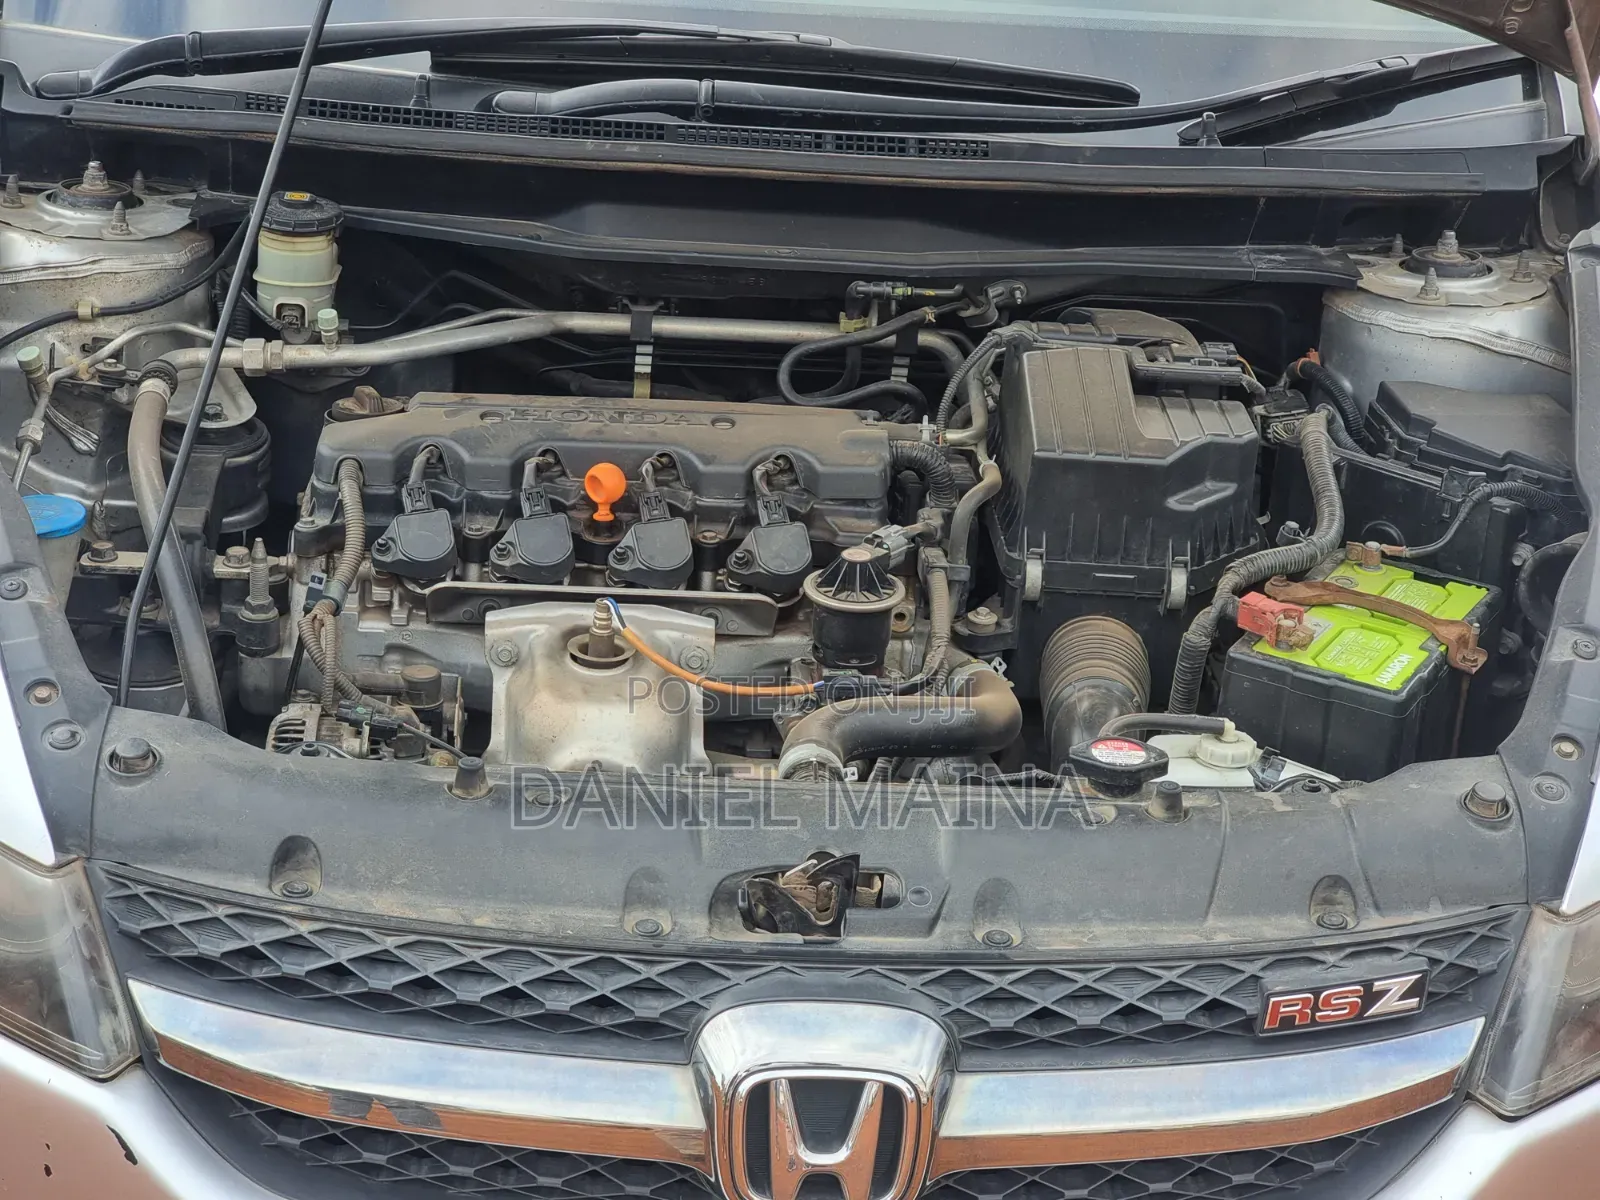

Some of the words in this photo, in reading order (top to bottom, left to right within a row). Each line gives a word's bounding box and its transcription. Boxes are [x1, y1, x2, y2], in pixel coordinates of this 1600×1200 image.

[510, 407, 707, 427] HONDA
[1375, 653, 1414, 685] AMARON
[1264, 974, 1423, 1029] RSZ
